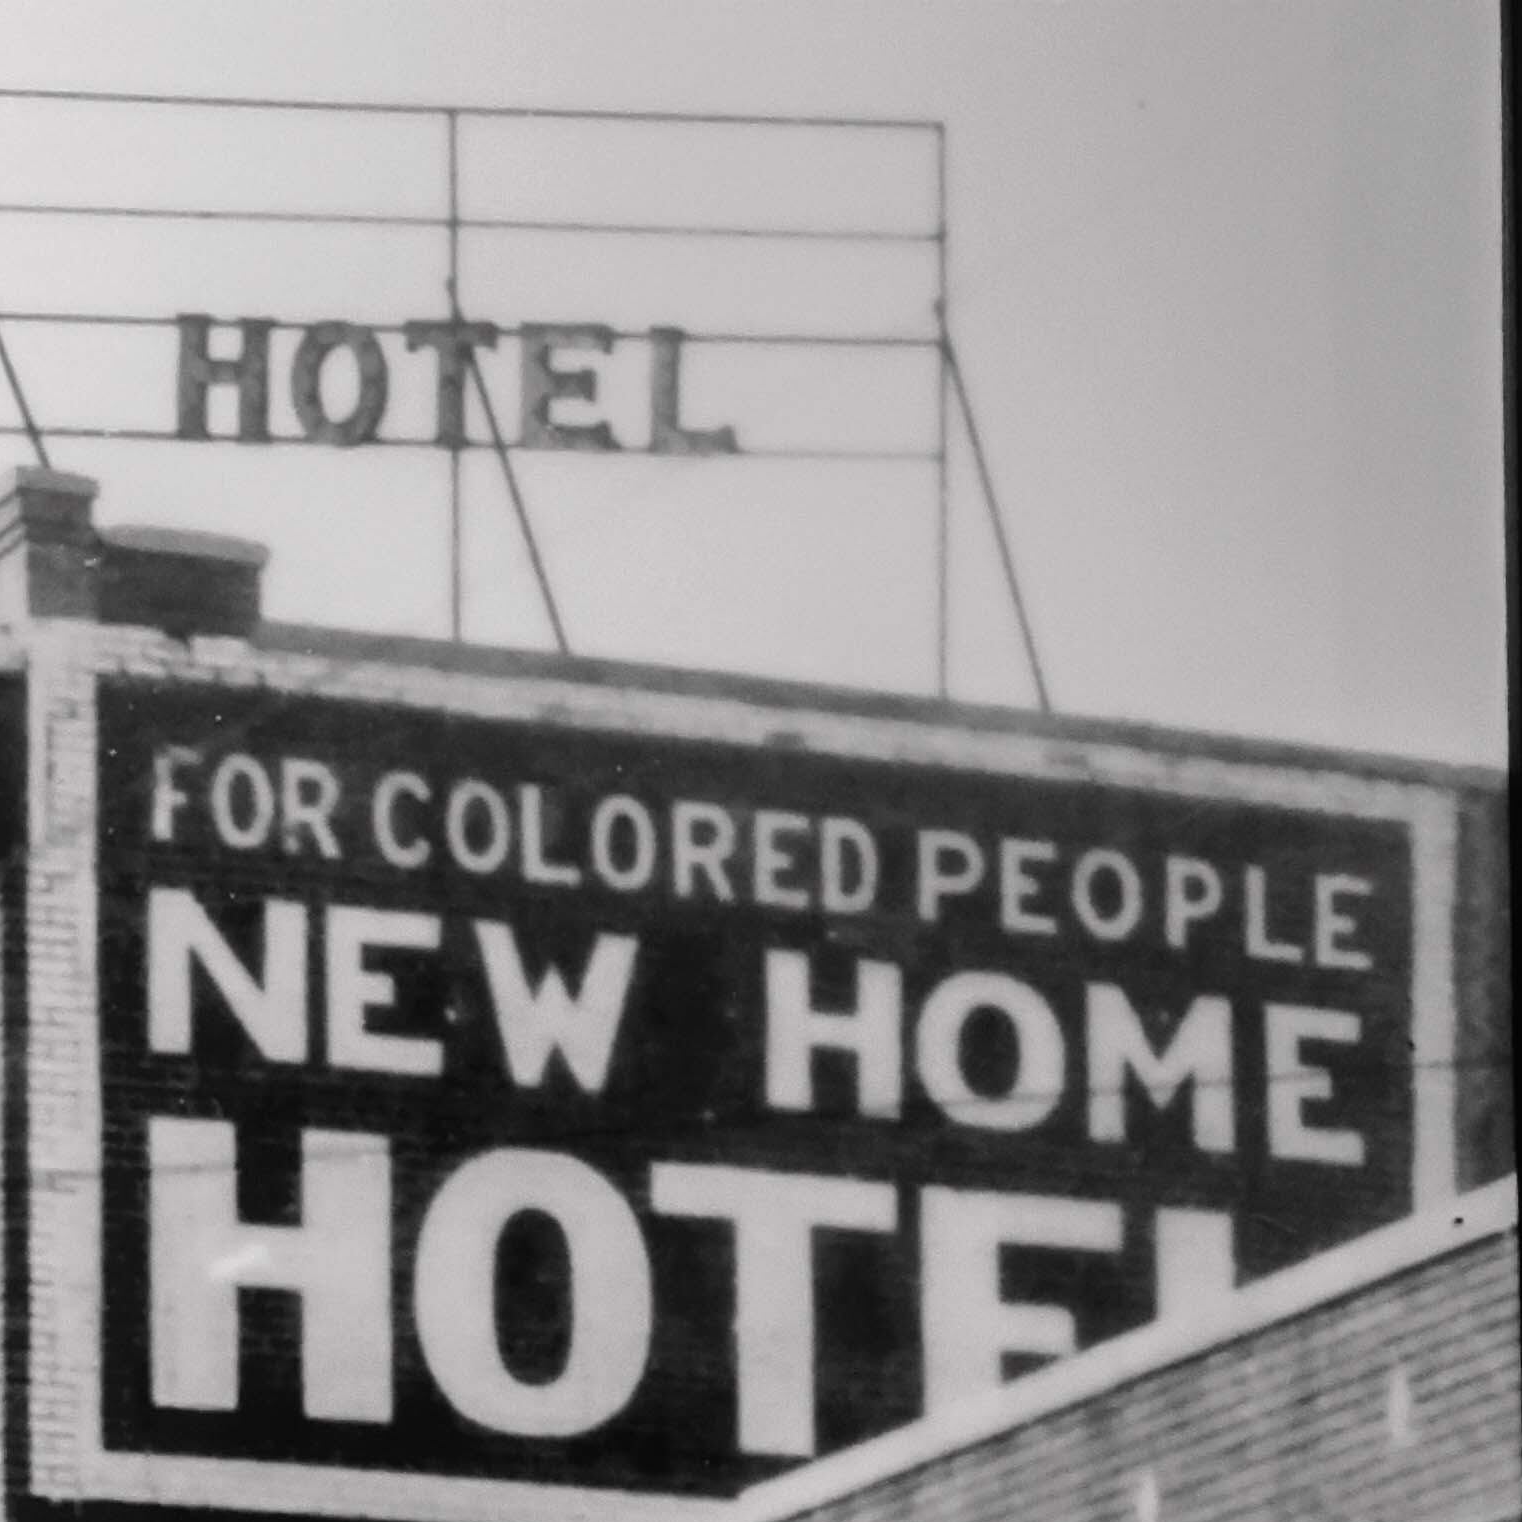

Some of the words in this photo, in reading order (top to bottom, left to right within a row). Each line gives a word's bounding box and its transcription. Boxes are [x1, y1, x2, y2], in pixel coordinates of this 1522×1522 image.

[177, 313, 740, 454] HOTEL
[151, 744, 343, 861] FOR
[374, 769, 879, 915] COLORED
[916, 827, 1374, 972] PEOPLE
[147, 886, 640, 1094] NEW
[764, 947, 1367, 1168] HOME
